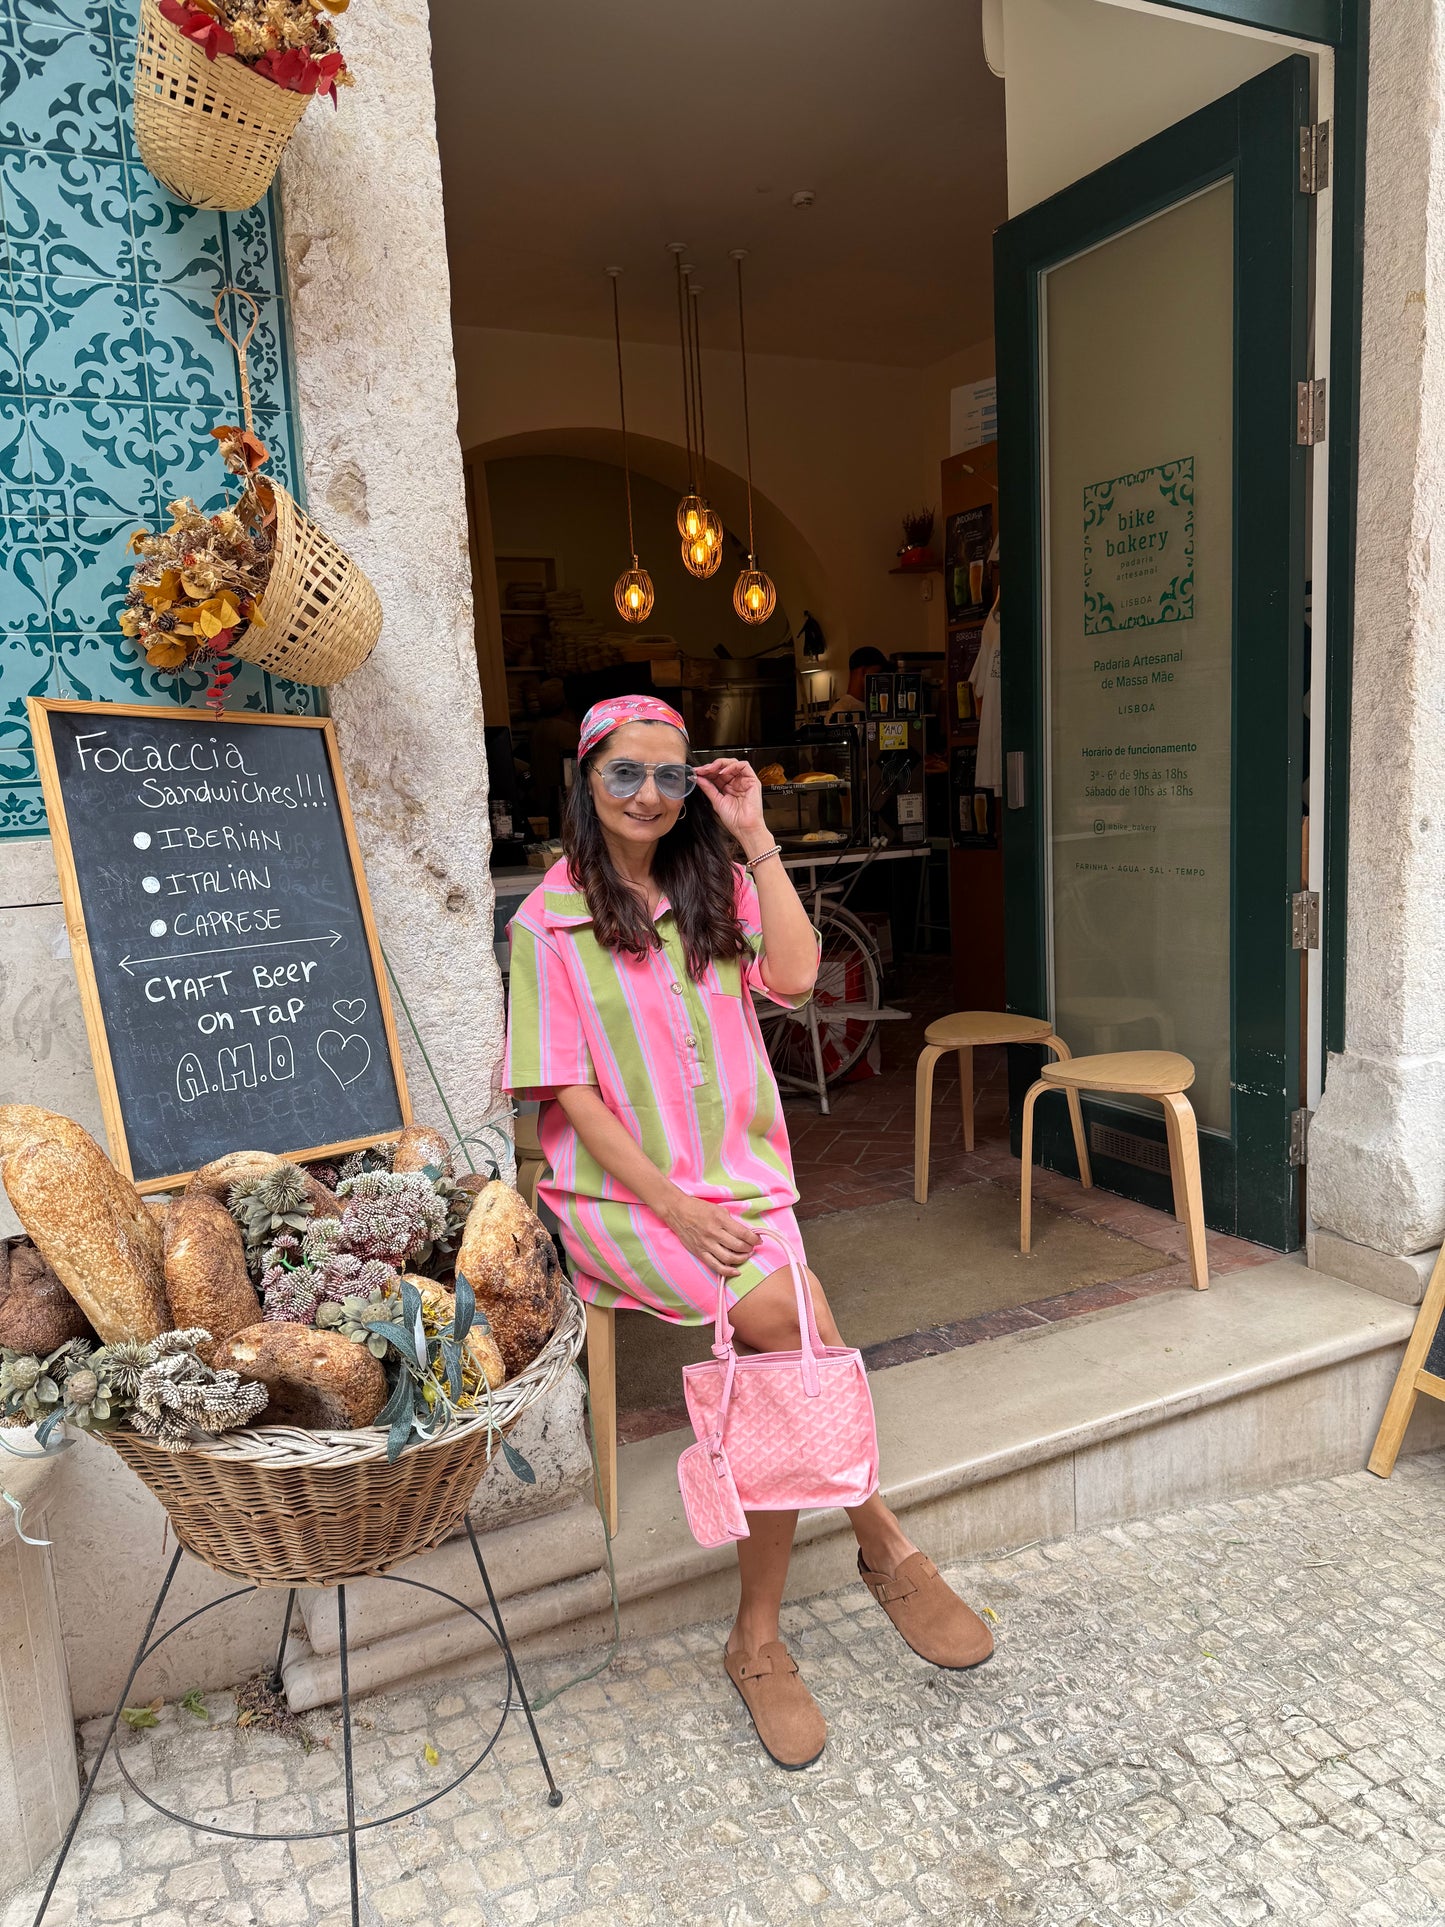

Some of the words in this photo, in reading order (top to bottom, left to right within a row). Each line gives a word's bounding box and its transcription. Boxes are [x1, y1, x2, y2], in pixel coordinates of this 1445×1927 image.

[1118, 509, 1155, 531] bike
[1106, 530, 1168, 557] bakery
[1120, 556, 1153, 570] padaria
[1116, 566, 1158, 581] artesanal
[1120, 595, 1152, 609] LISBOA
[1093, 656, 1130, 672] Padaria
[1132, 649, 1183, 667] Artesanal
[1101, 677, 1114, 690] de
[1116, 676, 1148, 688] Massa
[1151, 671, 1174, 684] Mãe
[1118, 703, 1155, 715] LISBOA
[76, 731, 258, 776] Focaccia
[1081, 746, 1113, 757] Horário
[1115, 745, 1126, 756] de
[1127, 742, 1198, 755] funcionamento
[1119, 768, 1131, 780] de
[1132, 768, 1150, 780] 9hs
[1165, 767, 1188, 780] 18hs
[138, 774, 328, 810] Sandwiches!!!
[1085, 785, 1117, 797] Sábado
[1119, 785, 1130, 797] de
[1133, 785, 1154, 797] 10hs
[1170, 784, 1193, 797] 18hs
[1075, 862, 1108, 872] FARINHA
[1149, 866, 1164, 875] SAL
[1175, 867, 1206, 877] TEMPO
[174, 908, 281, 937] CAPRESE
